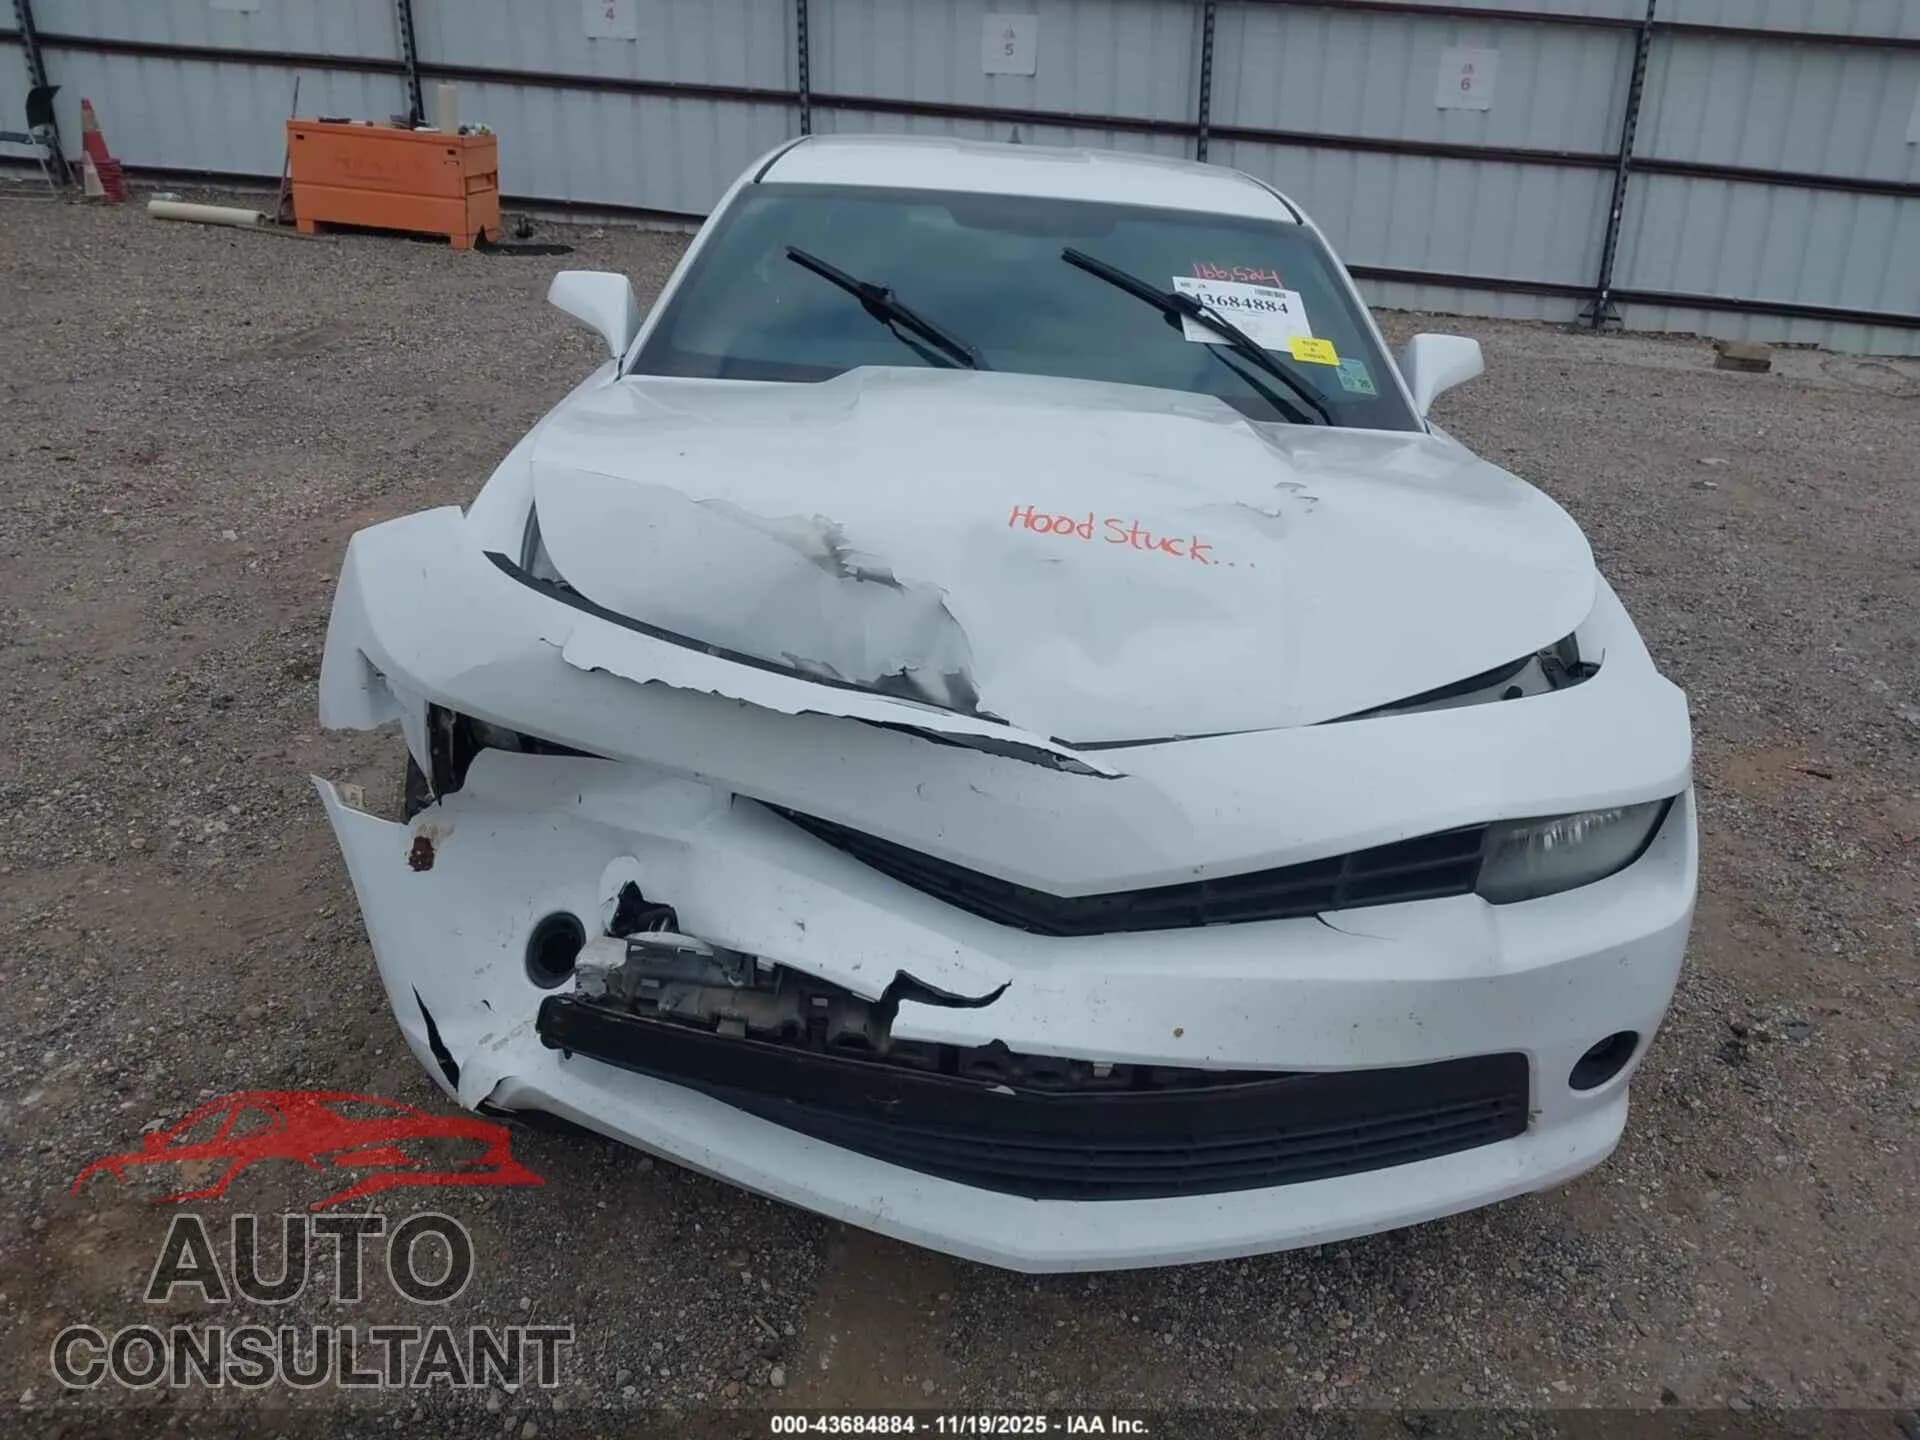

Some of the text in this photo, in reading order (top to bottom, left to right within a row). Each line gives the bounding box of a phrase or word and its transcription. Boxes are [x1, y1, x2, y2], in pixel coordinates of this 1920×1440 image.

[605, 7, 615, 20] 4
[1004, 42, 1014, 56] 5
[1460, 77, 1471, 91] 6
[1009, 505, 1094, 540] Hood
